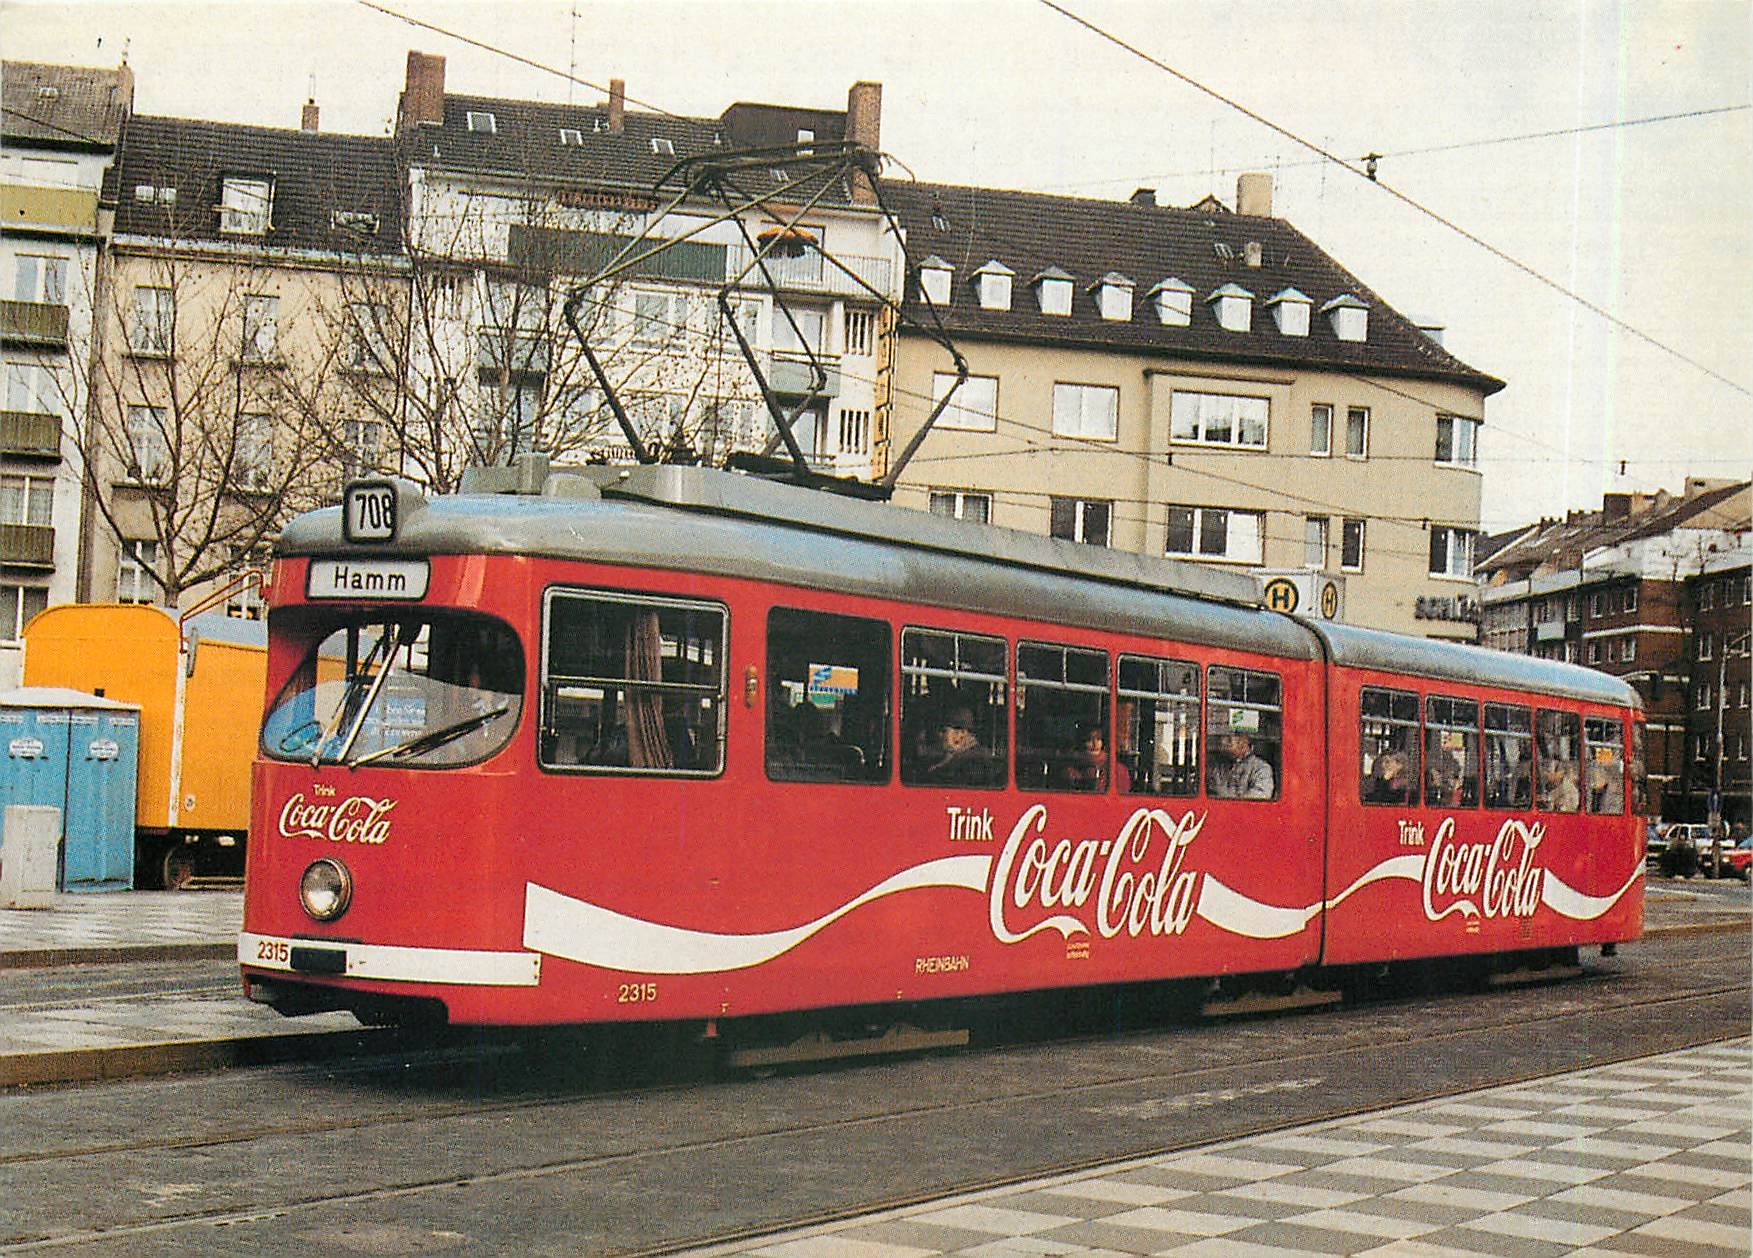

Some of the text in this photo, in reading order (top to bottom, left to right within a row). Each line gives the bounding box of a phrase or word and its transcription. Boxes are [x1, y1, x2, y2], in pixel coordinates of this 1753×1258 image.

[355, 492, 394, 530] 708
[334, 565, 406, 591] Hamm
[1271, 587, 1290, 610] H
[313, 783, 336, 797] Trink
[279, 793, 399, 844] Coca-Cola
[946, 806, 994, 841] Trink
[1397, 819, 1425, 846] Trink
[989, 803, 1208, 944] Coca-Cola
[1423, 816, 1547, 921] Coca-Cola
[257, 940, 289, 963] 2315
[915, 955, 970, 974] RHEINBAHN
[618, 982, 657, 1003] 2315
